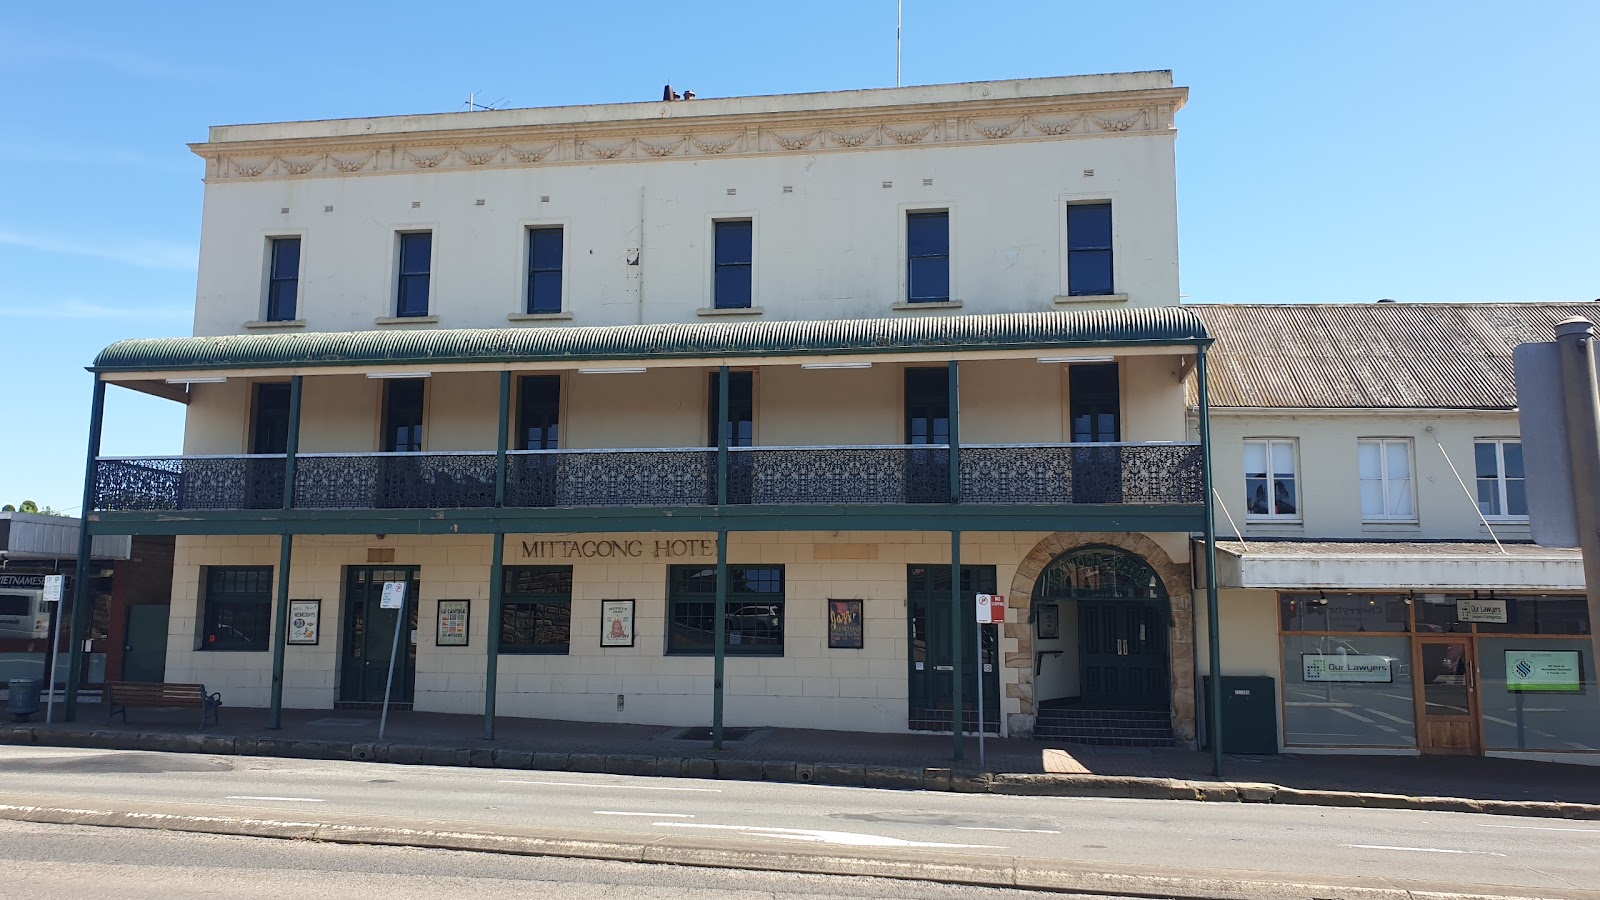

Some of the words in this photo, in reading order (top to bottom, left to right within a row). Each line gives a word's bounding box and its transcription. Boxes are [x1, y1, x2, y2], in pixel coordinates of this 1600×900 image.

[521, 540, 643, 558] MITTAGONG
[1328, 663, 1344, 671] Our
[1347, 663, 1388, 673] Lawyers
